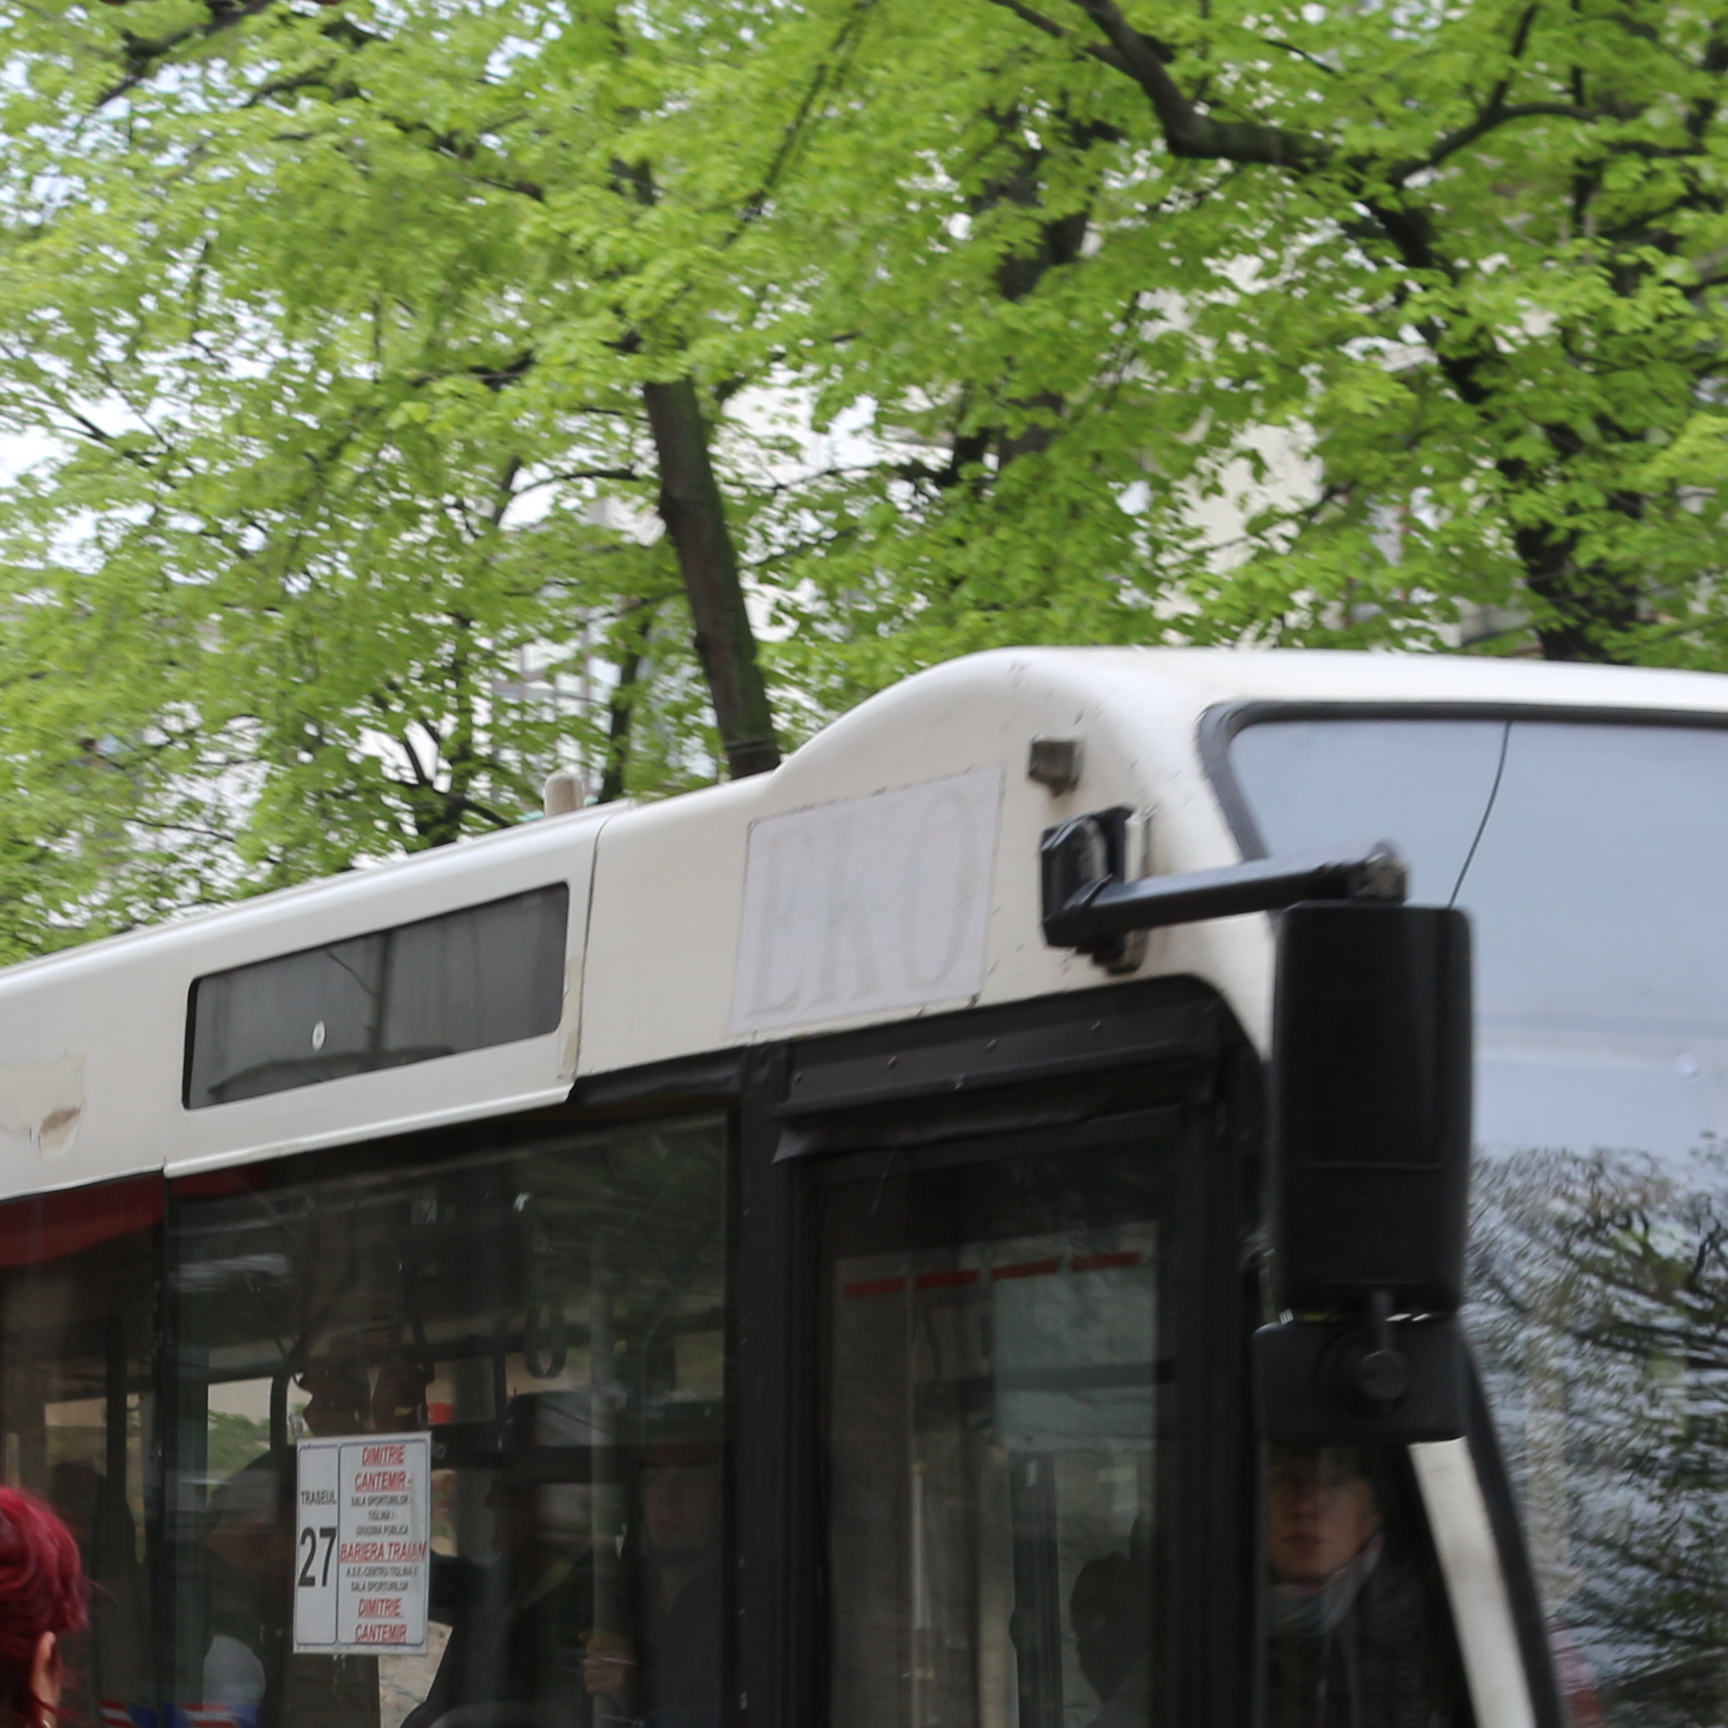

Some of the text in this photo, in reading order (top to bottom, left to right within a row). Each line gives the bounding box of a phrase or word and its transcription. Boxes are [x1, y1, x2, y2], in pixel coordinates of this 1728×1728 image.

[362, 1445, 405, 1466] DIMITRIE
[355, 1471, 406, 1492] CANTEMIR
[301, 1490, 337, 1505] TRASEUL
[298, 1526, 336, 1587] 27
[339, 1541, 427, 1562] BARIERA TRAIAN
[358, 1598, 402, 1617] DIMITRIE
[355, 1624, 407, 1643] CANTEMIR
